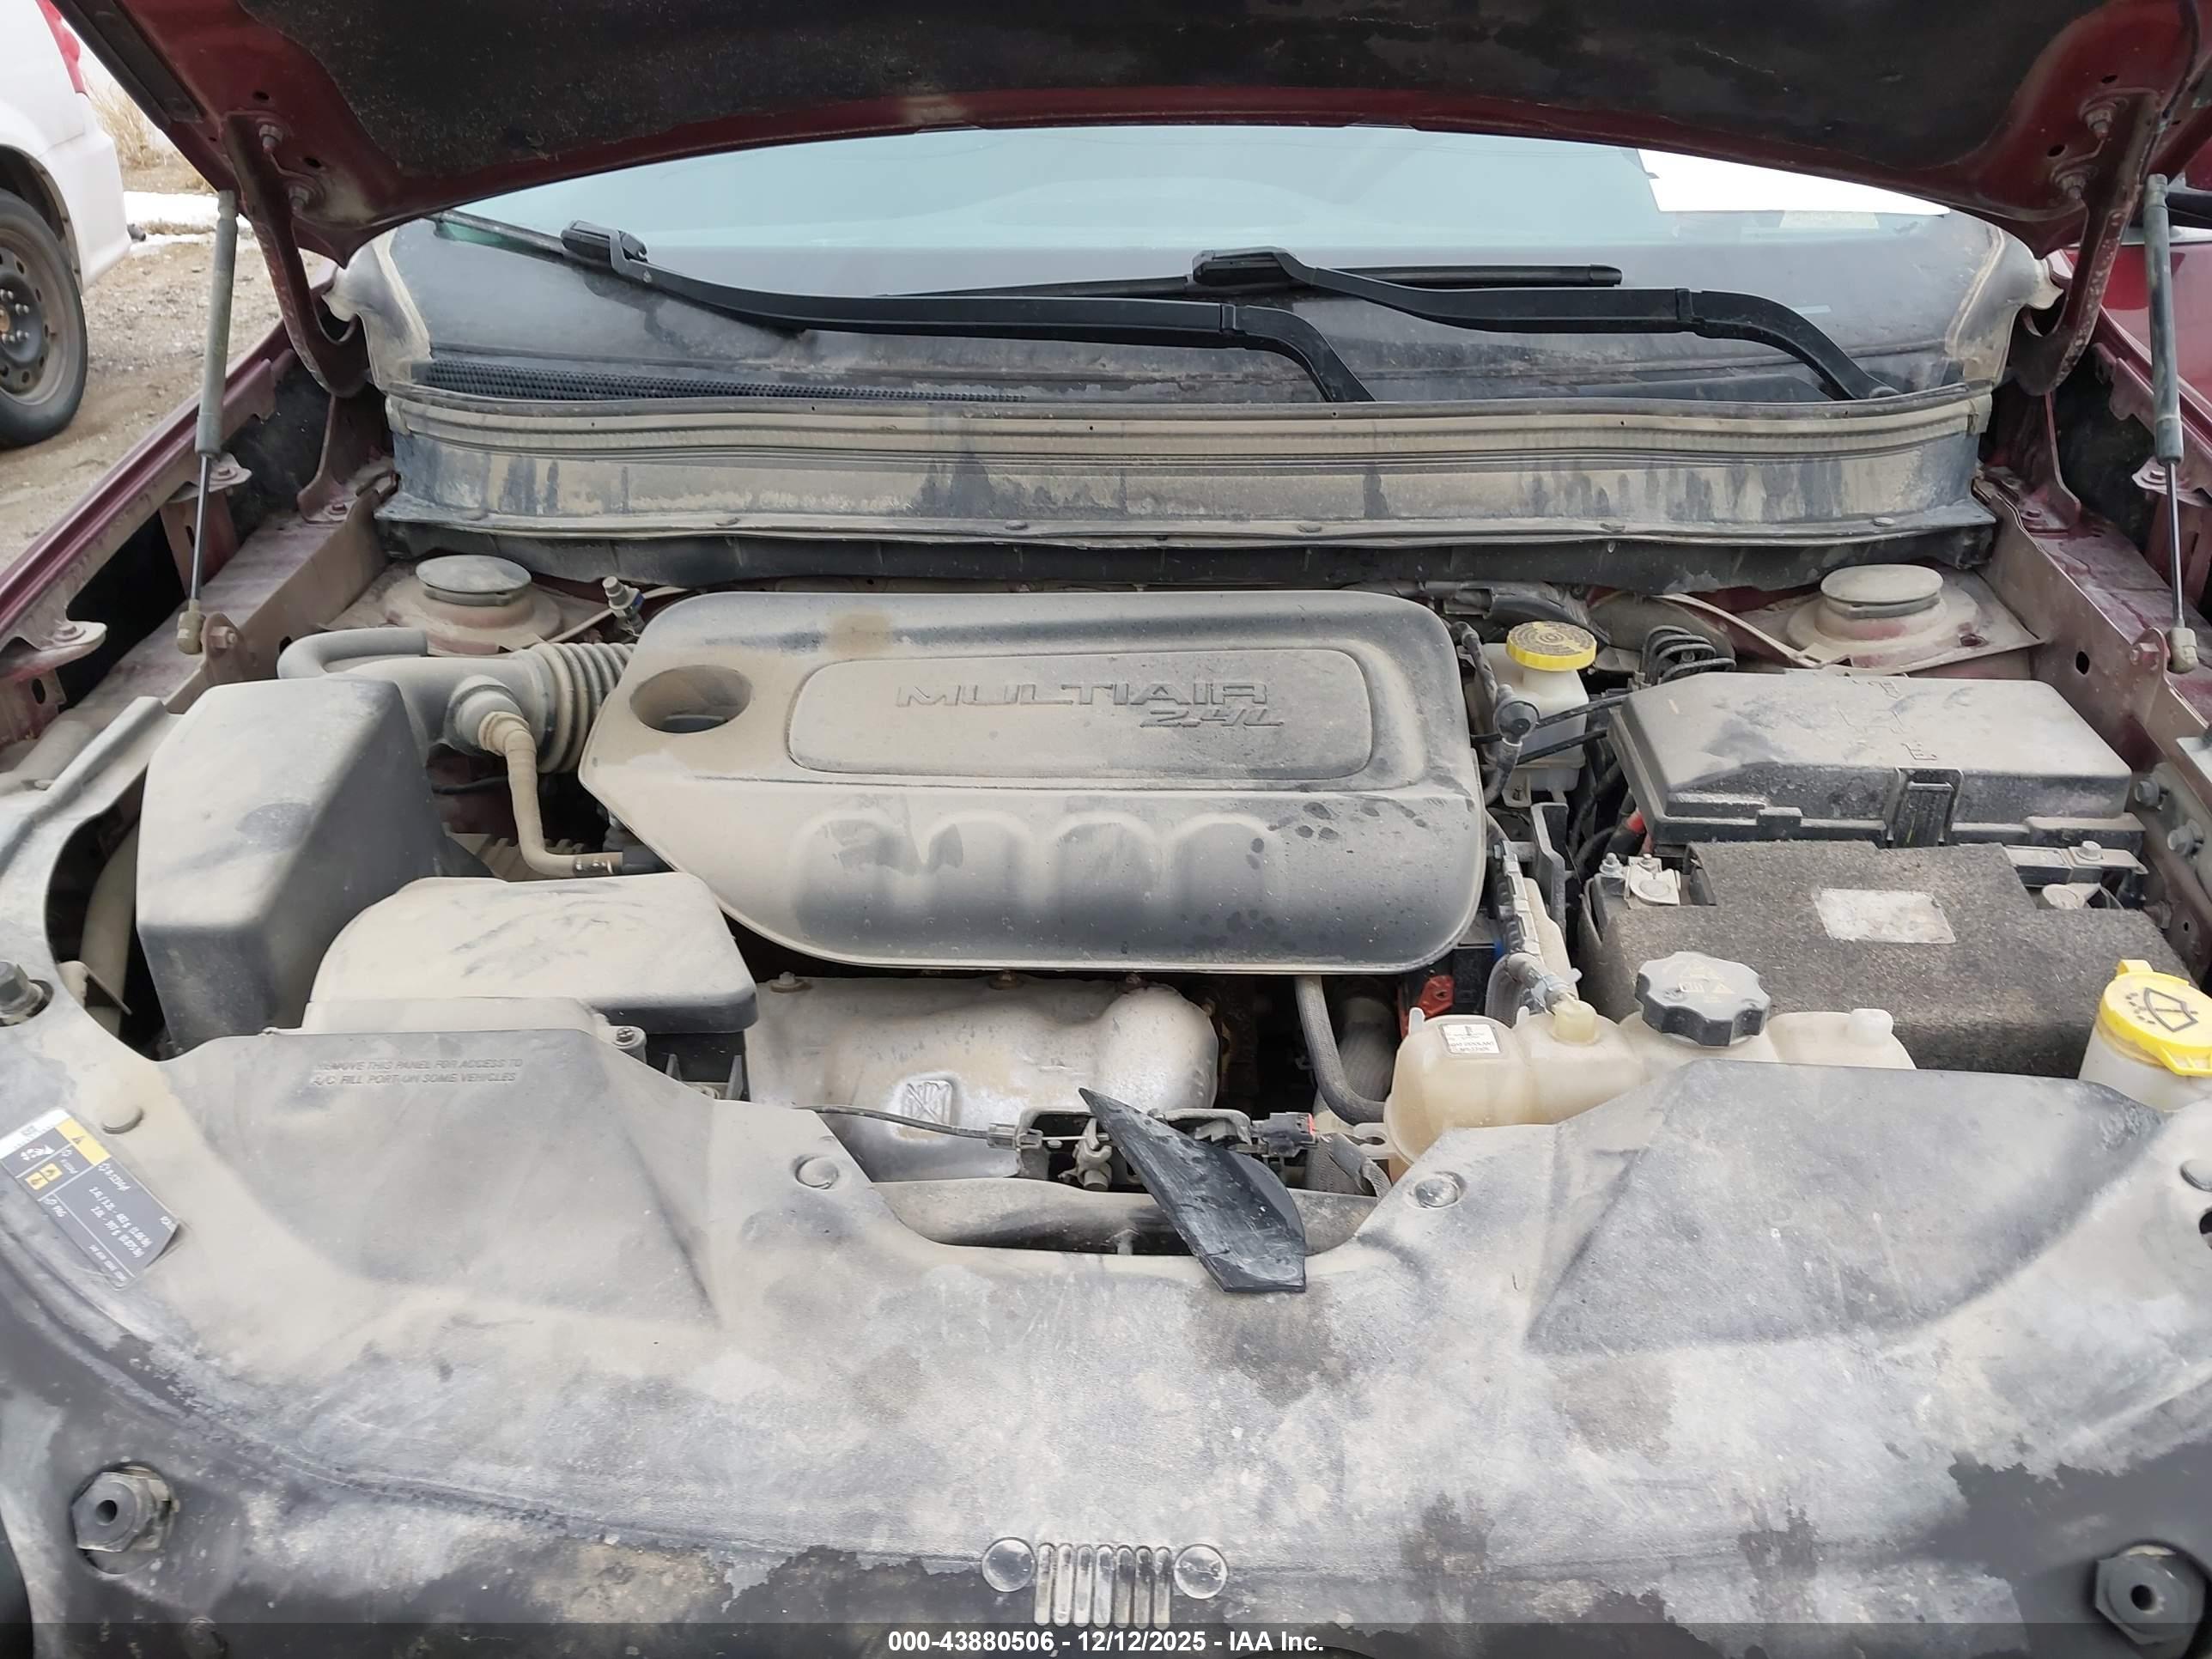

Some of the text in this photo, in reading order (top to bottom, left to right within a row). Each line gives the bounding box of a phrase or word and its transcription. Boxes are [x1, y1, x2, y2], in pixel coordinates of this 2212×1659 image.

[896, 682, 1267, 707] MULTIAIR
[1140, 708, 1284, 727] 2.4L
[367, 1060, 391, 1071] THIS
[396, 1060, 430, 1070] PANEL
[434, 1059, 459, 1069] FOR
[459, 1058, 505, 1068] ACCESS
[507, 1057, 523, 1067] TO
[340, 1074, 363, 1085] FILL
[368, 1074, 398, 1085] PORT
[422, 1073, 457, 1083] SOME
[460, 1072, 516, 1082] VEHICLES
